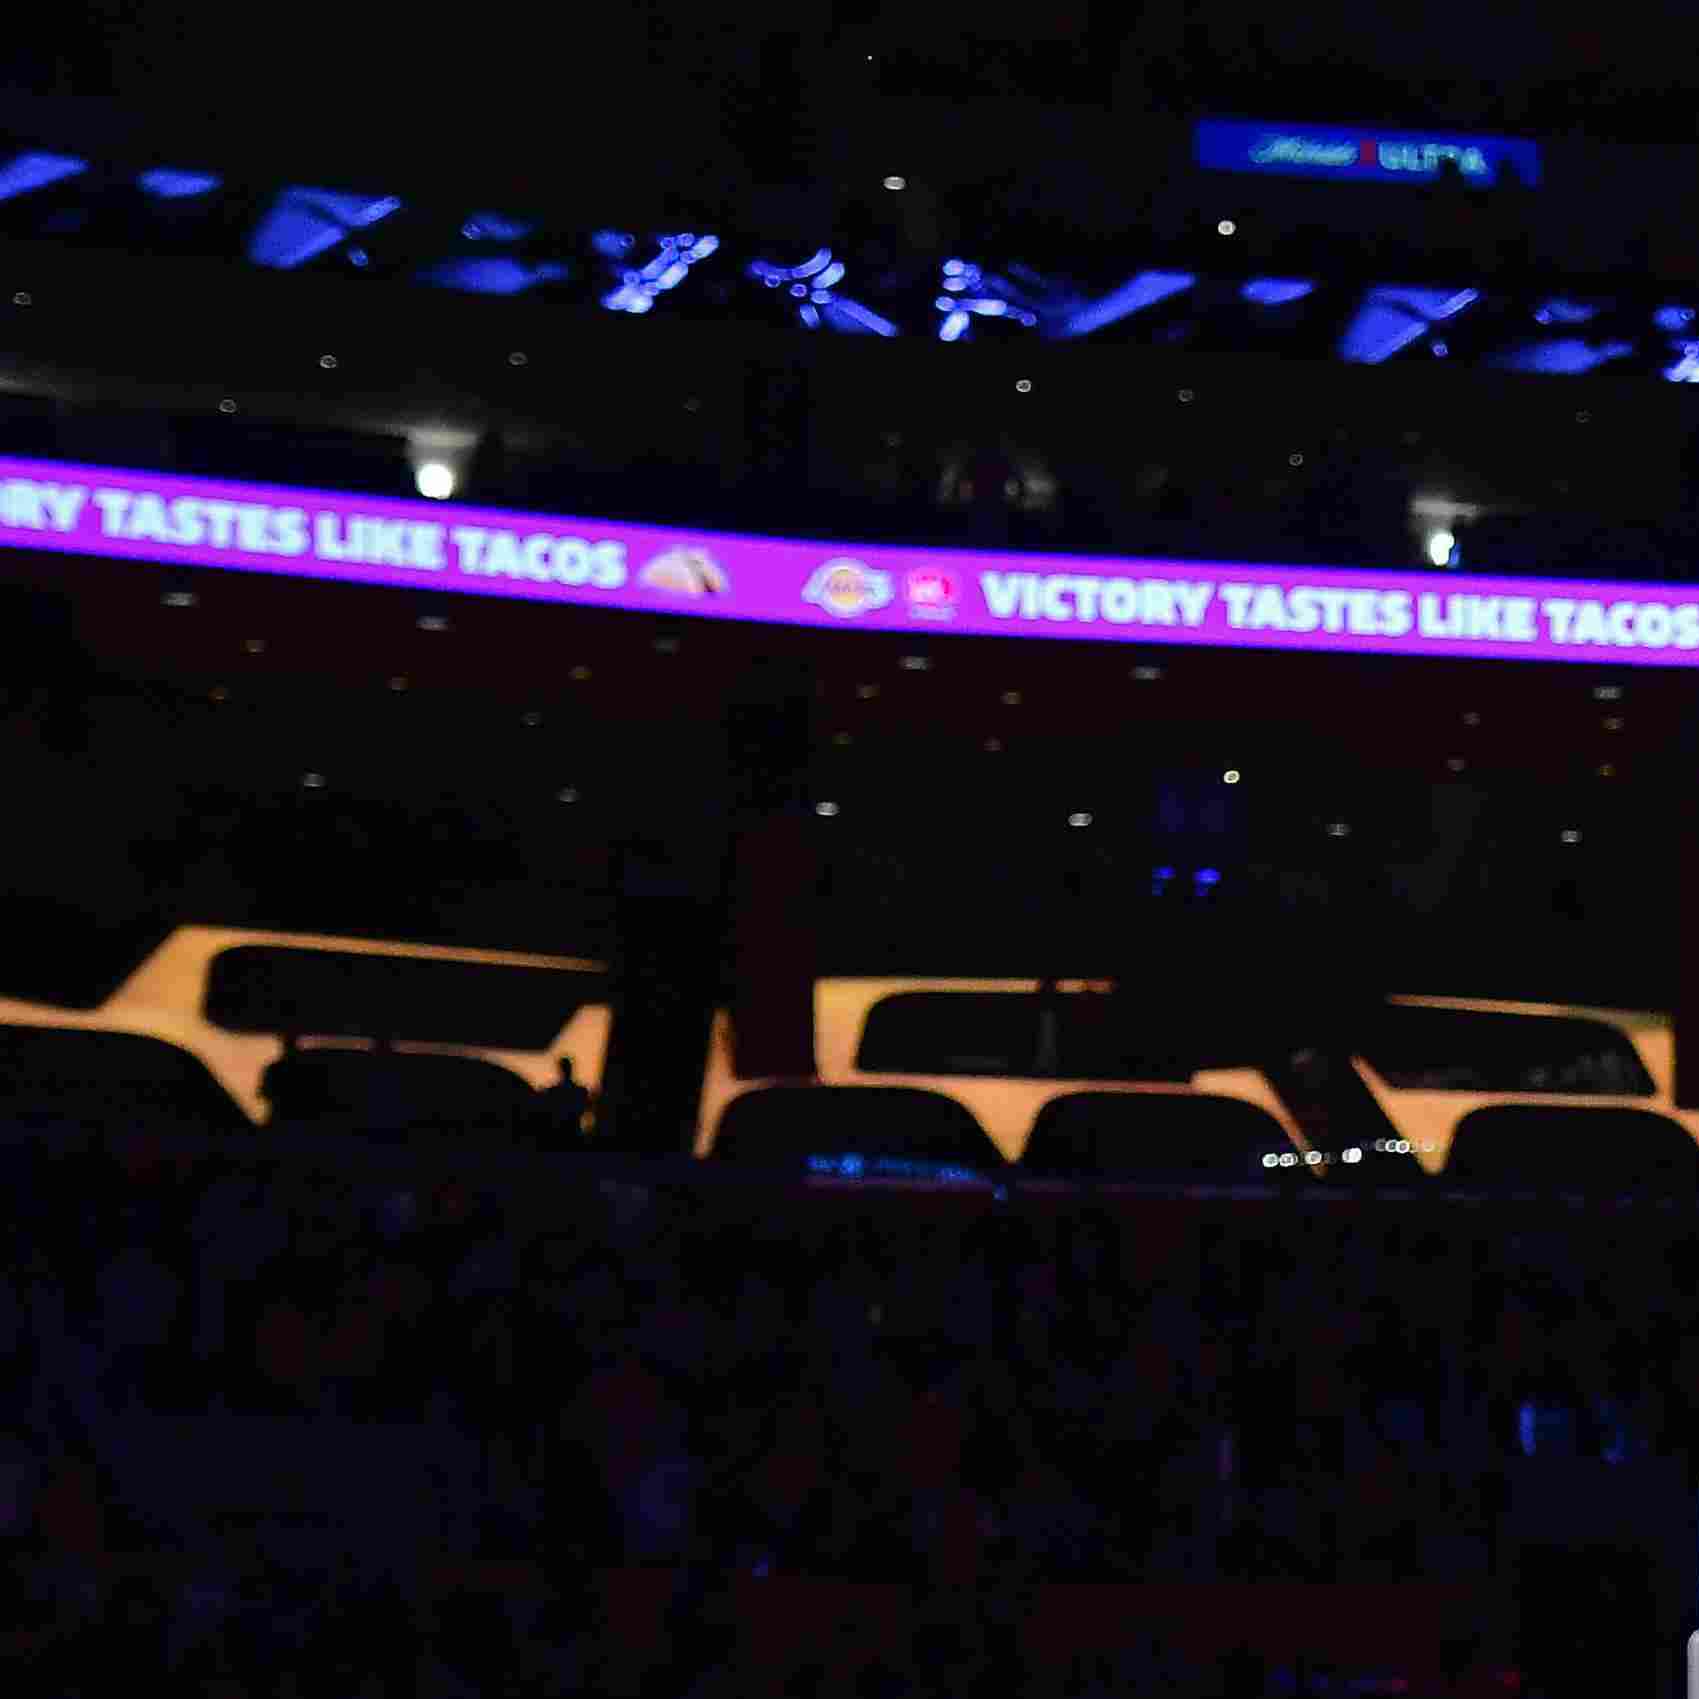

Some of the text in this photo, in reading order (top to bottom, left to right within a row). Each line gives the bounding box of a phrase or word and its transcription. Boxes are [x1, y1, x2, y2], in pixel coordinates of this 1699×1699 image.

[0, 477, 628, 590] RY TASTES LIKE TACOS
[980, 570, 1213, 626] VICTORY
[1218, 582, 1414, 638] TASTES
[1418, 593, 1537, 642] LIKE
